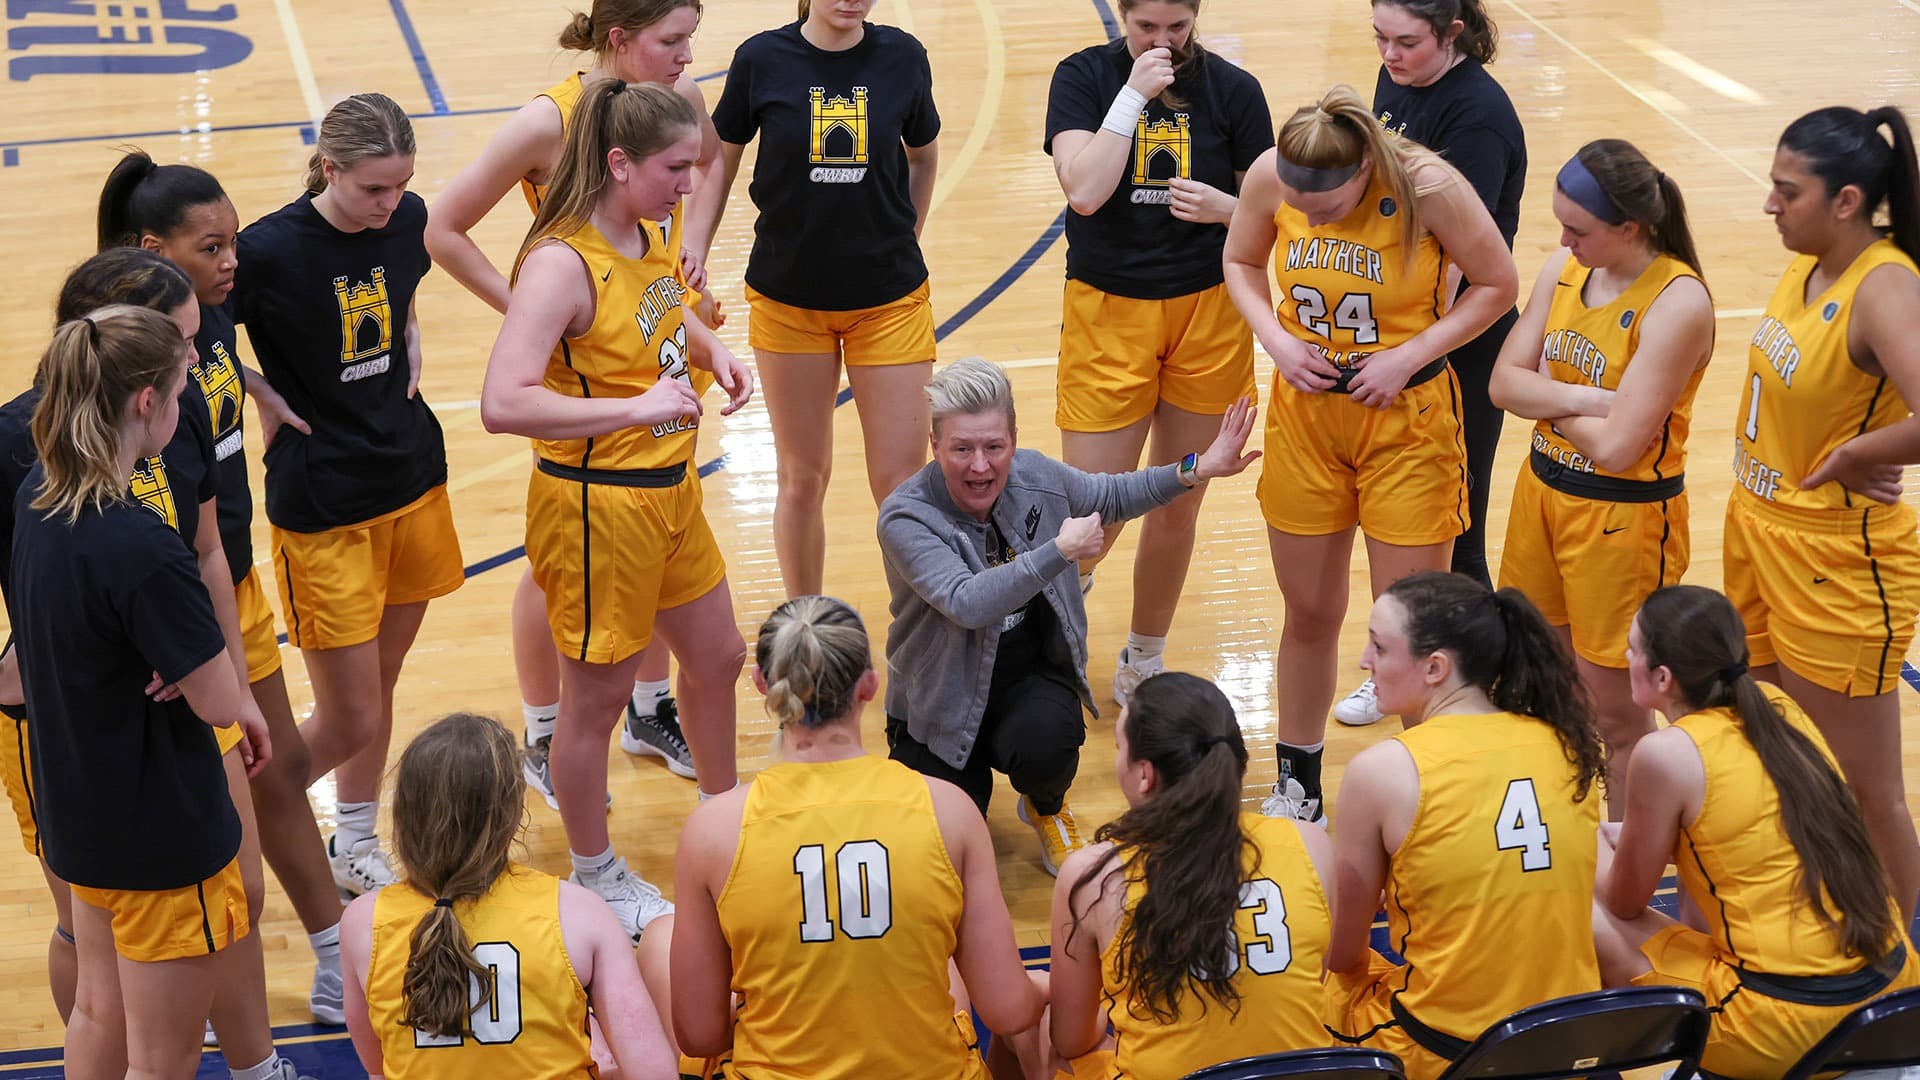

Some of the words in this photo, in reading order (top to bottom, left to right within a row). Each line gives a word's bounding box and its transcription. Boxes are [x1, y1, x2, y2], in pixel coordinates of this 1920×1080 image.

[809, 167, 867, 183] CWRU
[1130, 188, 1171, 205] CWR
[1285, 237, 1383, 285] MATHER
[1291, 283, 1379, 344] 24
[340, 354, 390, 382] CWRU
[1752, 316, 1801, 389] ATHER
[1745, 372, 1762, 443] 1
[1494, 777, 1551, 873] 4
[793, 839, 892, 943] 10
[1187, 877, 1292, 982] 3
[413, 940, 522, 1048] 0
